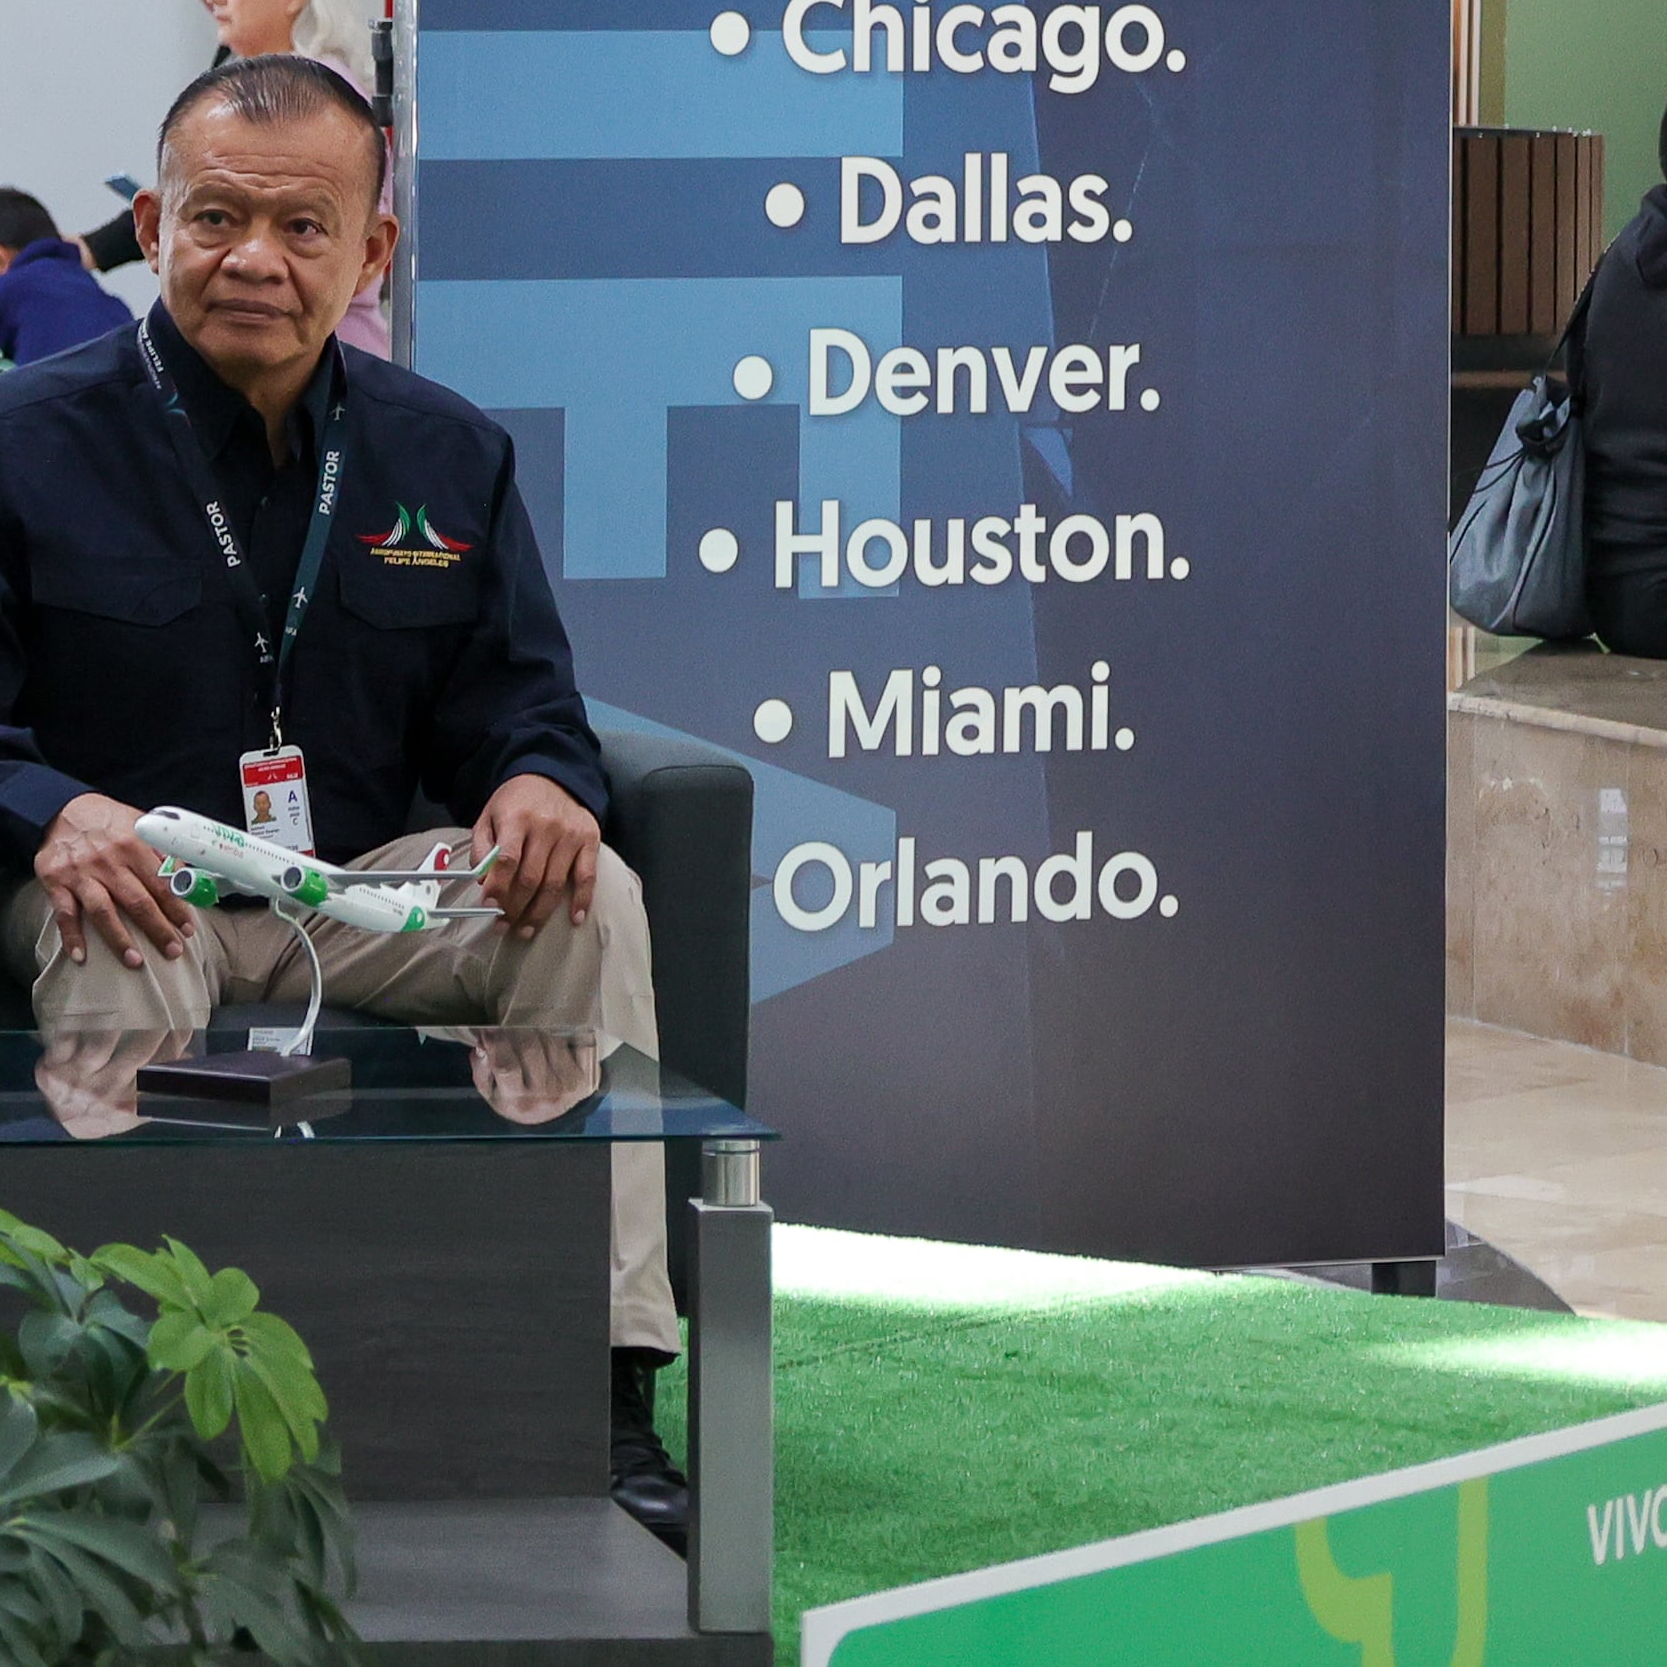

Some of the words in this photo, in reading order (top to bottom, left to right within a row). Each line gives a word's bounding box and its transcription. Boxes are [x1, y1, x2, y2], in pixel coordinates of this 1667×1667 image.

[841, 153, 1132, 244] Dallas.
[810, 329, 1159, 415] Denver.
[318, 450, 341, 516] PASTOR
[206, 500, 242, 568] PASTOR
[775, 500, 1189, 588] Houston.
[829, 661, 1134, 758] Miami.
[288, 790, 298, 803] A
[774, 831, 1178, 931] Orlando.
